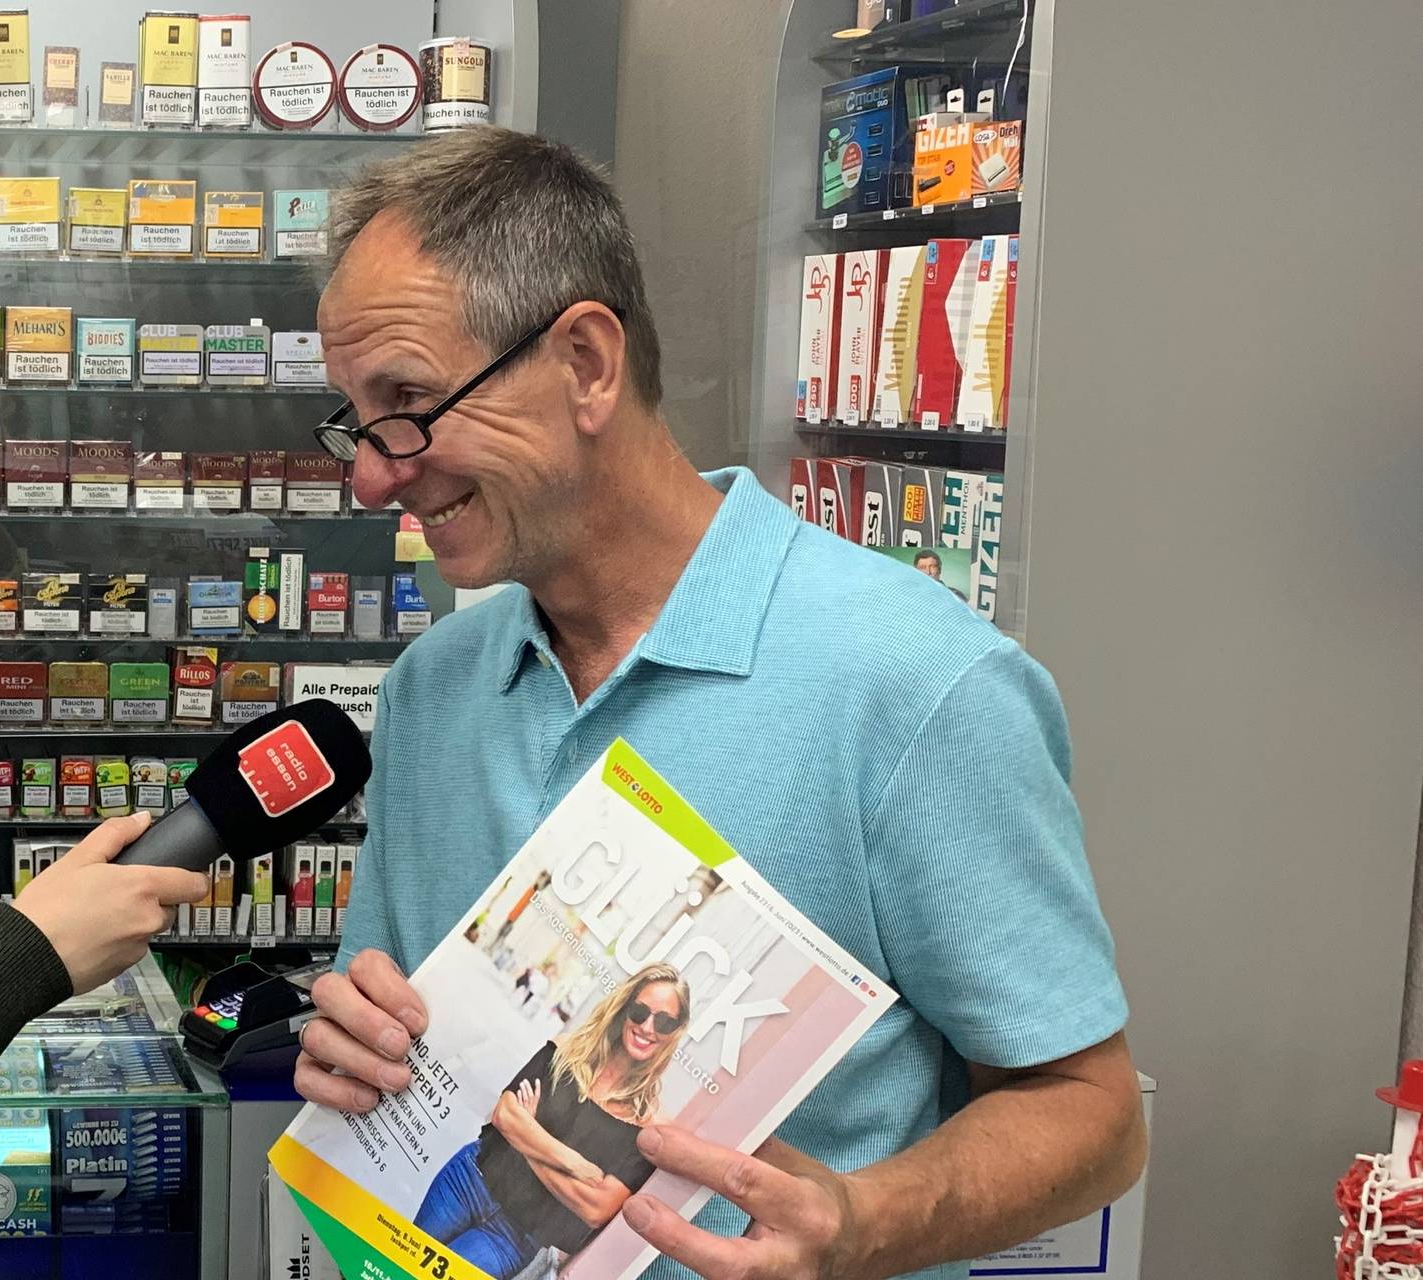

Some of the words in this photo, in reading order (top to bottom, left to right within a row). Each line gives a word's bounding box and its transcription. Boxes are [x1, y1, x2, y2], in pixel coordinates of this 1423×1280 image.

[444, 56, 484, 66] SUNGOLD
[148, 90, 192, 102] Rauchen
[203, 92, 248, 103] Rauchen
[269, 87, 310, 98] Rauchen
[312, 85, 325, 95] ist
[354, 89, 395, 100] Rauchen
[397, 89, 409, 98] ist
[145, 104, 157, 113] ist
[159, 103, 193, 114] tödlich
[281, 97, 314, 108] tödlich
[365, 99, 398, 109] tödlich
[201, 106, 214, 115] ist
[215, 105, 250, 115] tödlich
[425, 108, 460, 119] auchen
[918, 124, 969, 152] GIZEH
[999, 126, 1018, 138] Dreh
[13, 320, 66, 337] MEHARI'S
[141, 325, 178, 337] CLUB
[207, 325, 244, 337] CLUB
[883, 276, 912, 392] Marlboro
[971, 269, 1006, 392] Marlboro
[206, 339, 264, 351] MASTER
[15, 355, 59, 364] Rauchen
[28, 364, 63, 374] tödlich
[12, 447, 60, 458] MOODS
[78, 448, 125, 458] MOODS
[294, 458, 337, 468] MOODS
[905, 491, 913, 519] 200
[960, 479, 970, 535] MENTHOL
[867, 500, 880, 546] est
[978, 474, 1004, 612] GIZEH
[318, 593, 346, 603] Burton
[0, 676, 33, 685] RED
[119, 677, 161, 686] GREEN
[302, 684, 326, 695] Alle
[329, 683, 380, 698] Prepaid
[334, 700, 372, 712] usch
[280, 743, 309, 781] radio
[266, 748, 297, 792] essen
[611, 762, 635, 785] WEST
[637, 787, 663, 815] LOTTO
[529, 890, 548, 913] Das
[546, 909, 596, 970] kostenlose
[550, 839, 791, 1077] GLÜCK
[673, 1048, 720, 1095] stLotto
[428, 1060, 459, 1096] JETZT
[405, 1055, 437, 1101] TIPPEN
[440, 1106, 451, 1120] 3
[411, 1115, 427, 1136] UND
[65, 1128, 127, 1148] 500.000€
[389, 1109, 420, 1151] KNATTERN
[422, 1155, 430, 1164] 4
[66, 1156, 127, 1174] Platin
[379, 1162, 387, 1172] 6
[419, 1245, 450, 1280] 73
